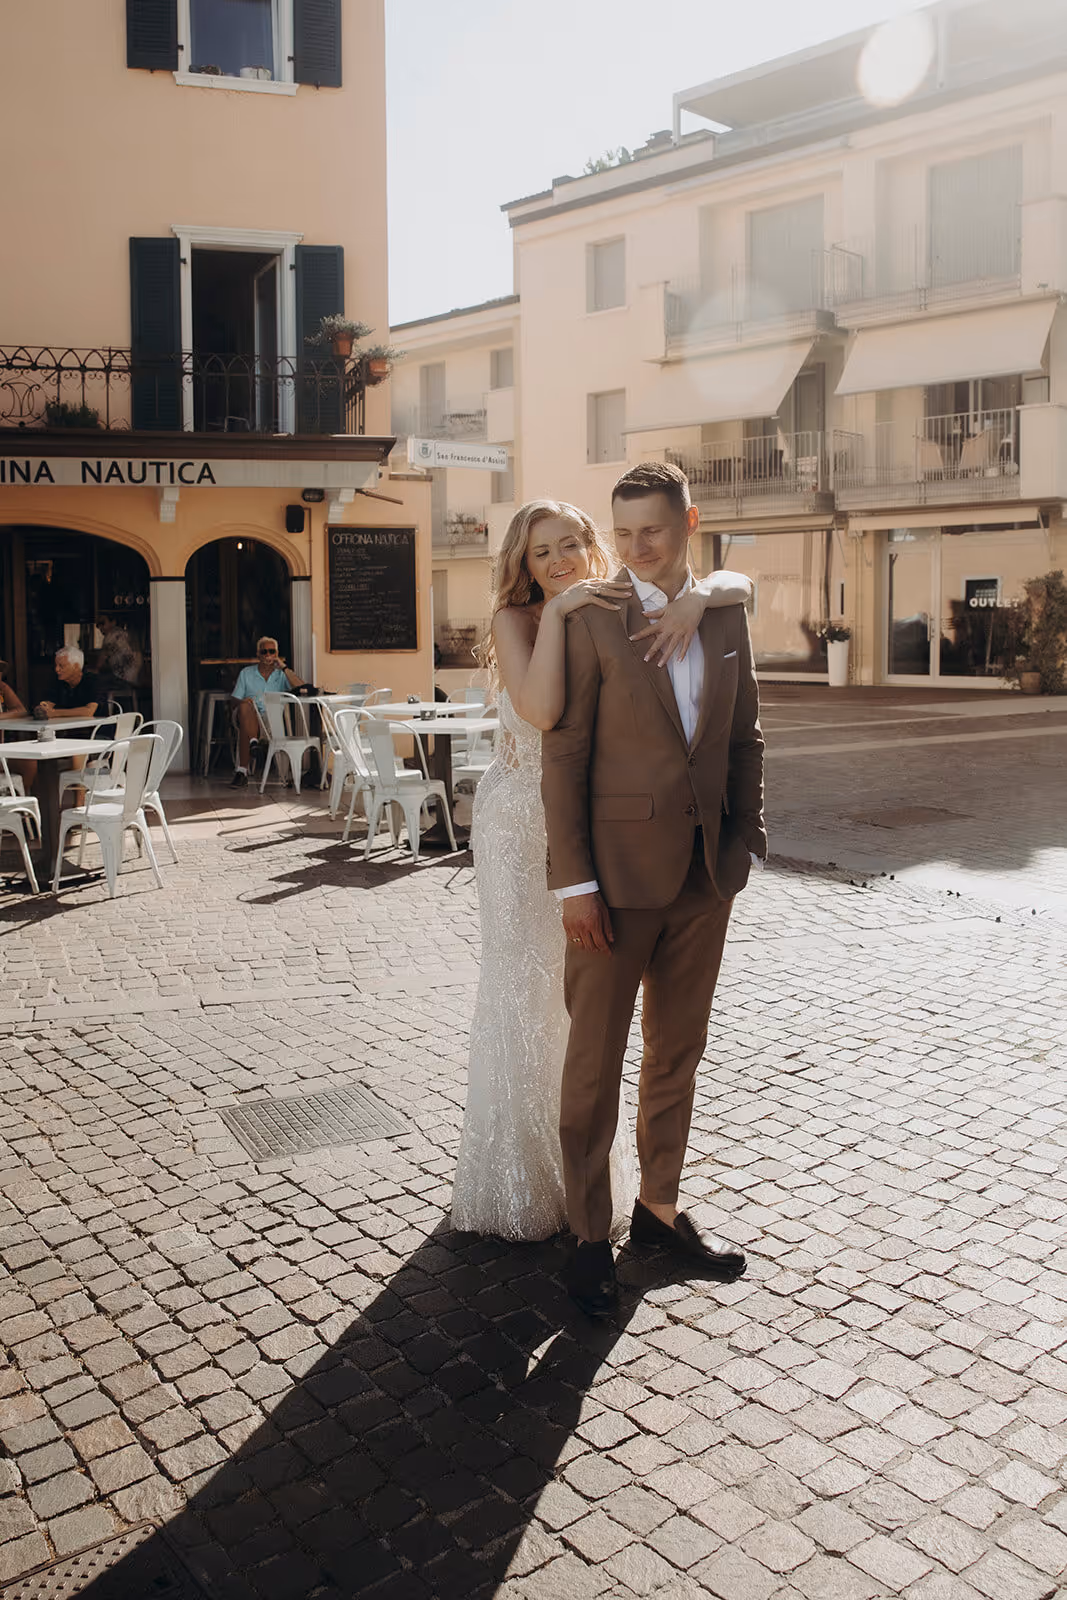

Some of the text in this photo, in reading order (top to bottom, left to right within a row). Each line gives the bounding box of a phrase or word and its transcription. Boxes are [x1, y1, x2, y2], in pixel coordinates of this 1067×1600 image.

[437, 452, 449, 460] San
[450, 453, 481, 463] Francesco
[0, 460, 216, 484] INA NAUTICA
[969, 597, 1020, 608] OUTLET
